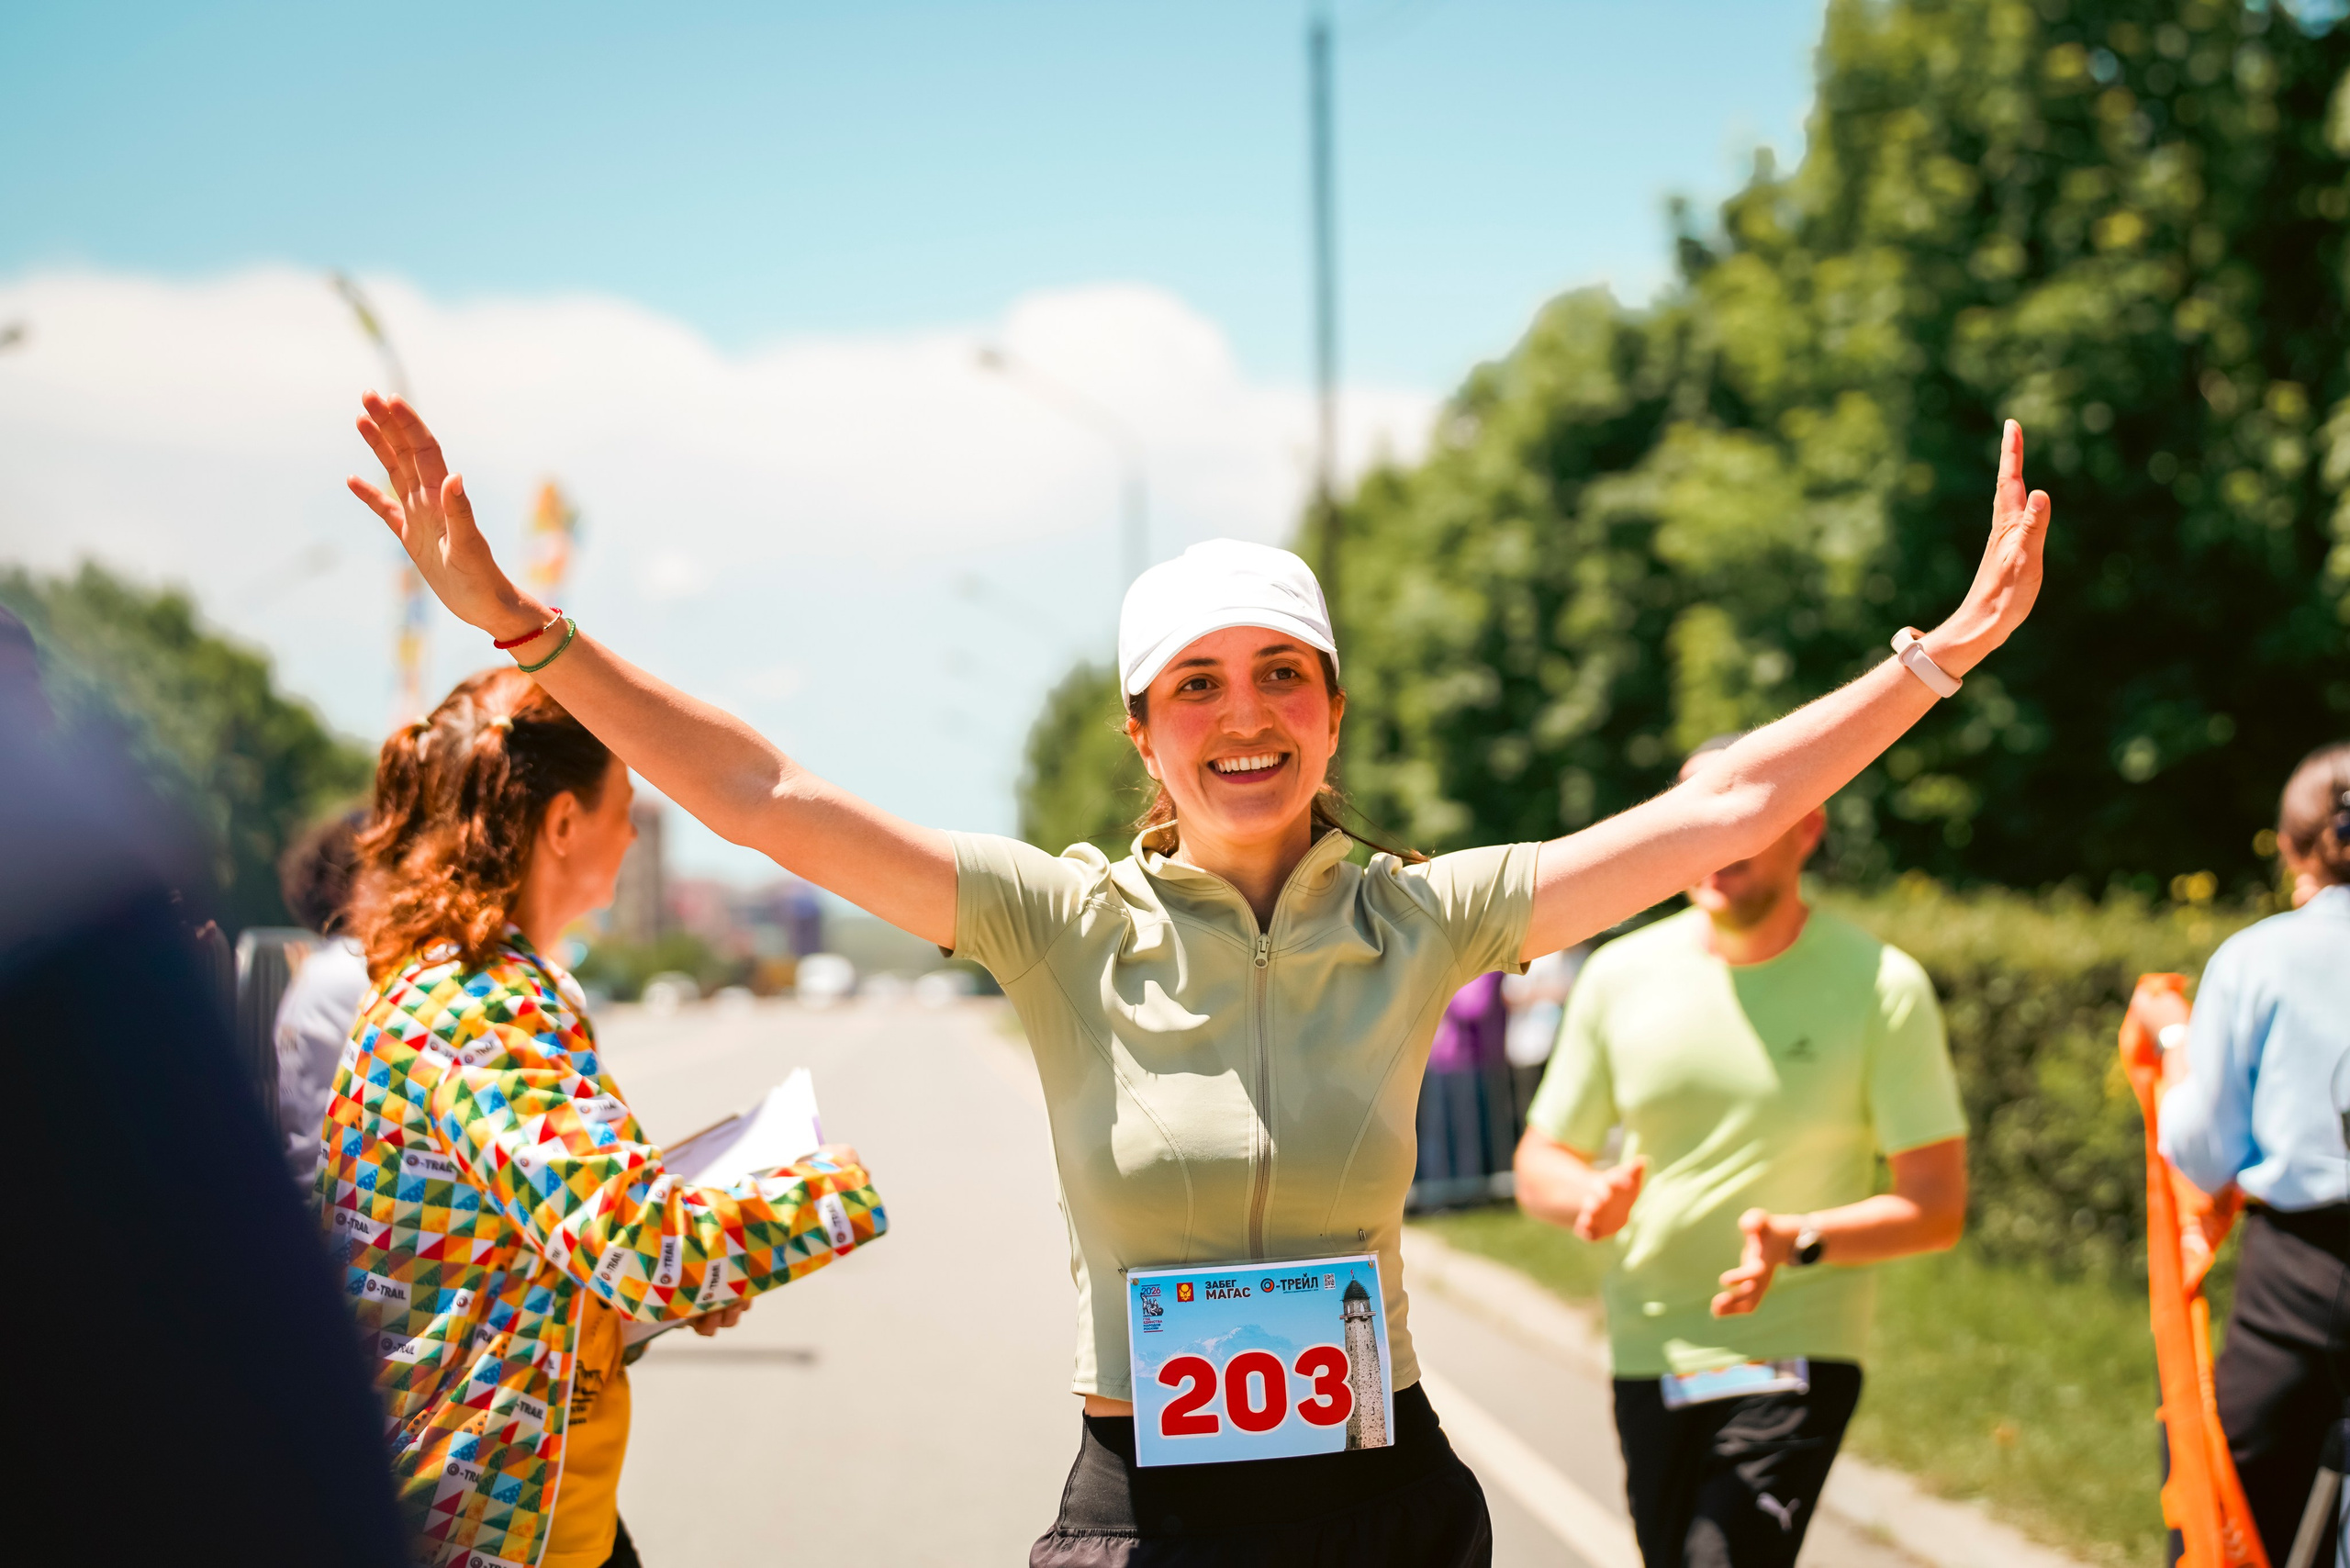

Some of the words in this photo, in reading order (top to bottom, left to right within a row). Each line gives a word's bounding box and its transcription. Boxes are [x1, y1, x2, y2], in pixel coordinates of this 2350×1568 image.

[1141, 1286, 1161, 1294] 2026
[1205, 1280, 1237, 1289] ЗАБЕГ
[1205, 1287, 1250, 1300] МАГАС
[1157, 1344, 1354, 1438] 203
